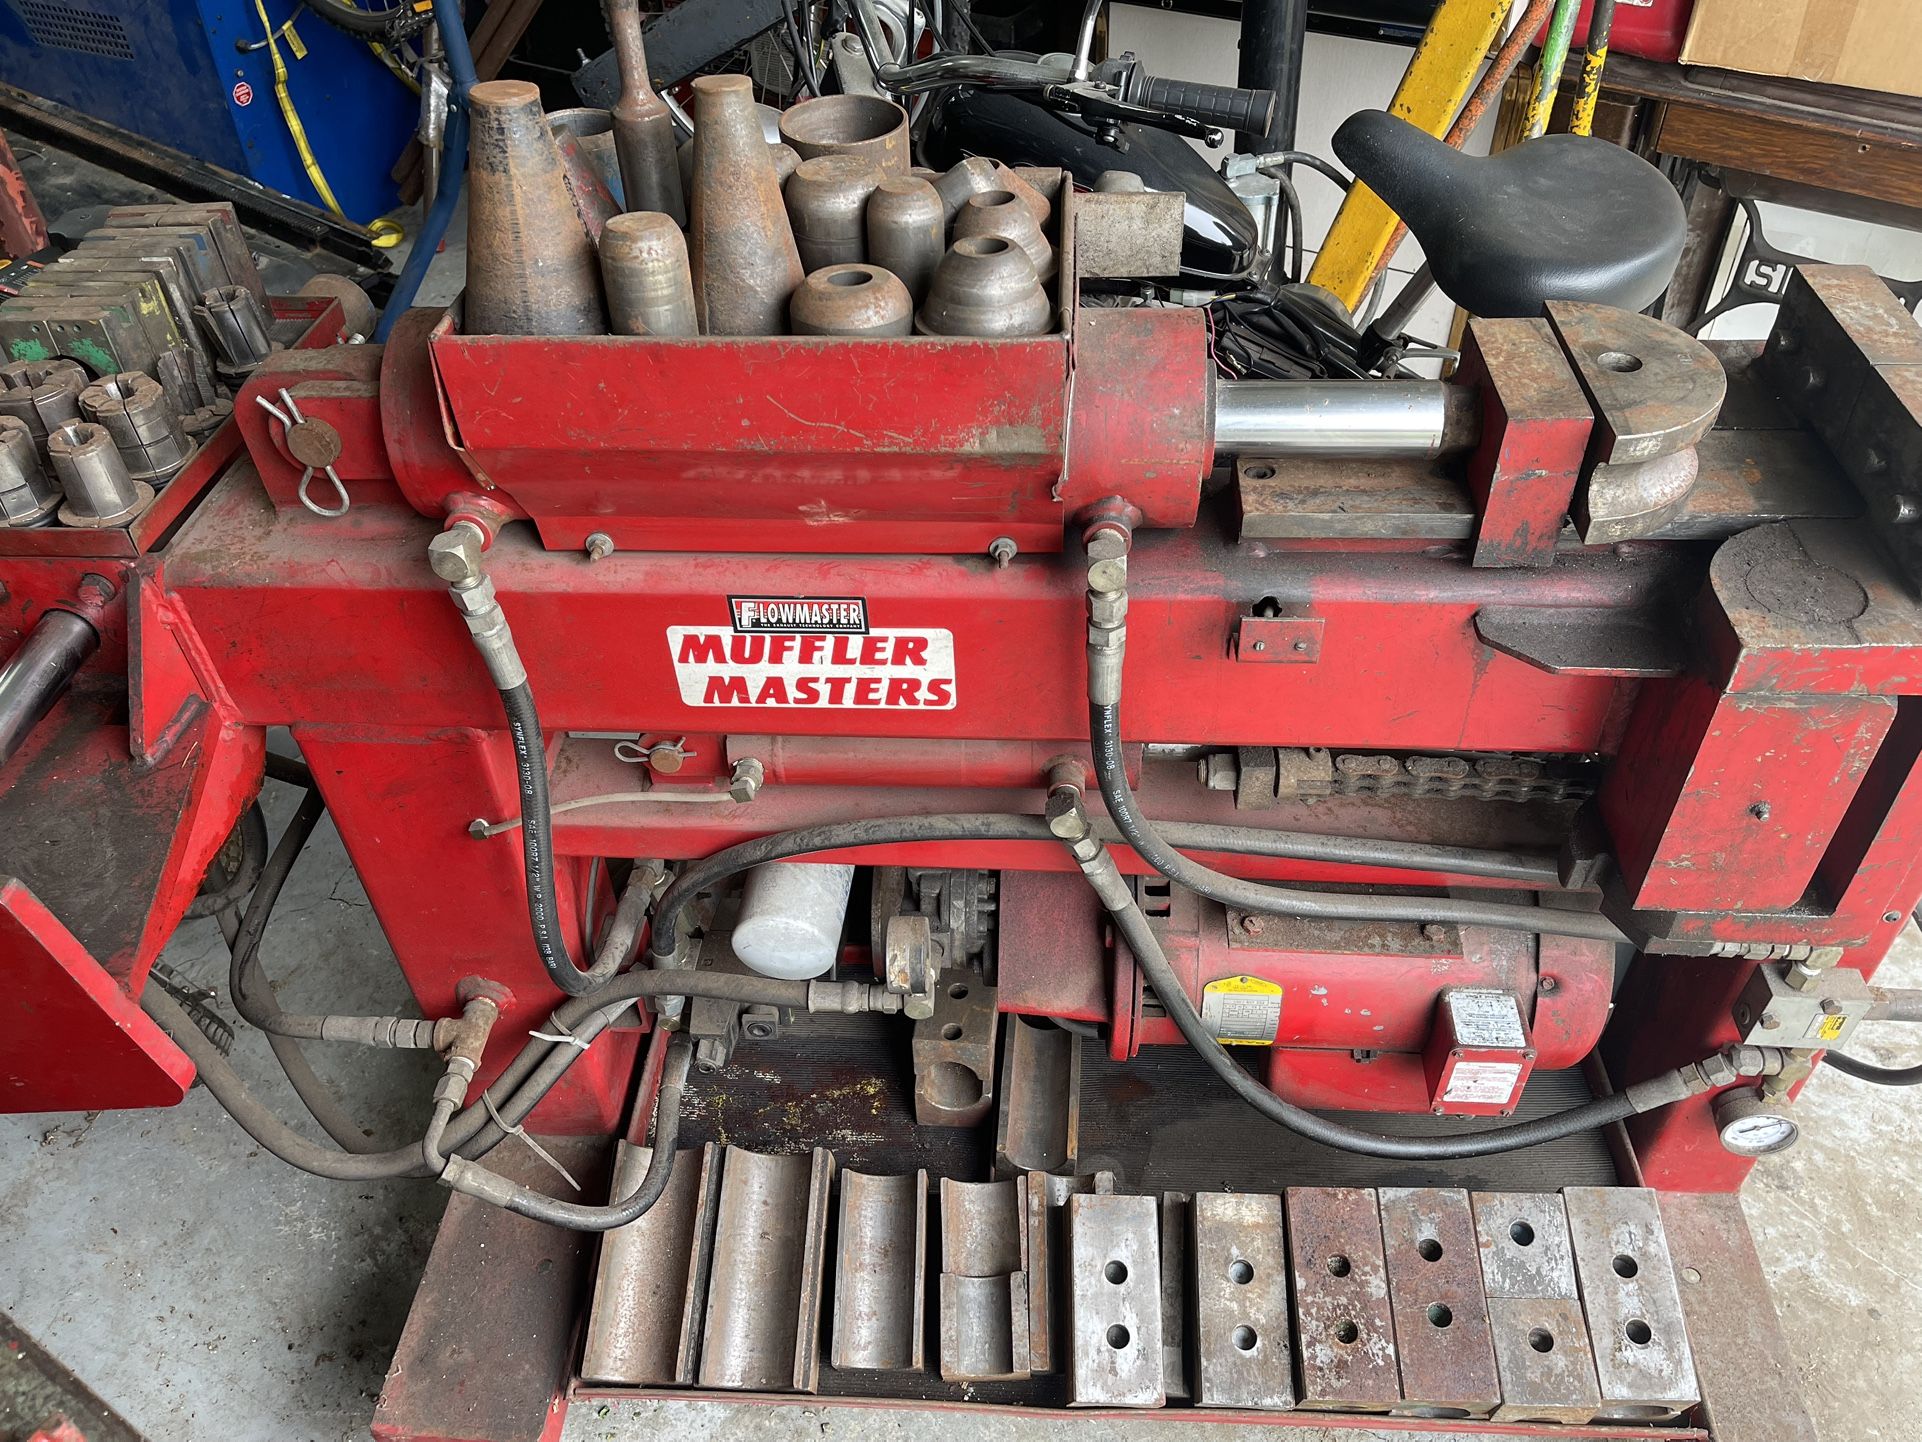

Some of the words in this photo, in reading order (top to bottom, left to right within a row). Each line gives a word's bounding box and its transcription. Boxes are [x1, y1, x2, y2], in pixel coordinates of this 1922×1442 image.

[740, 601, 860, 627] FLOWMASTER
[677, 634, 929, 666] MUFFLER
[703, 675, 953, 706] MASTERS
[1104, 740, 1116, 770] 3130-08
[521, 762, 533, 795] 3130-08
[1112, 789, 1124, 803] SAE
[527, 819, 536, 834] SAE
[534, 903, 545, 921] 2000
